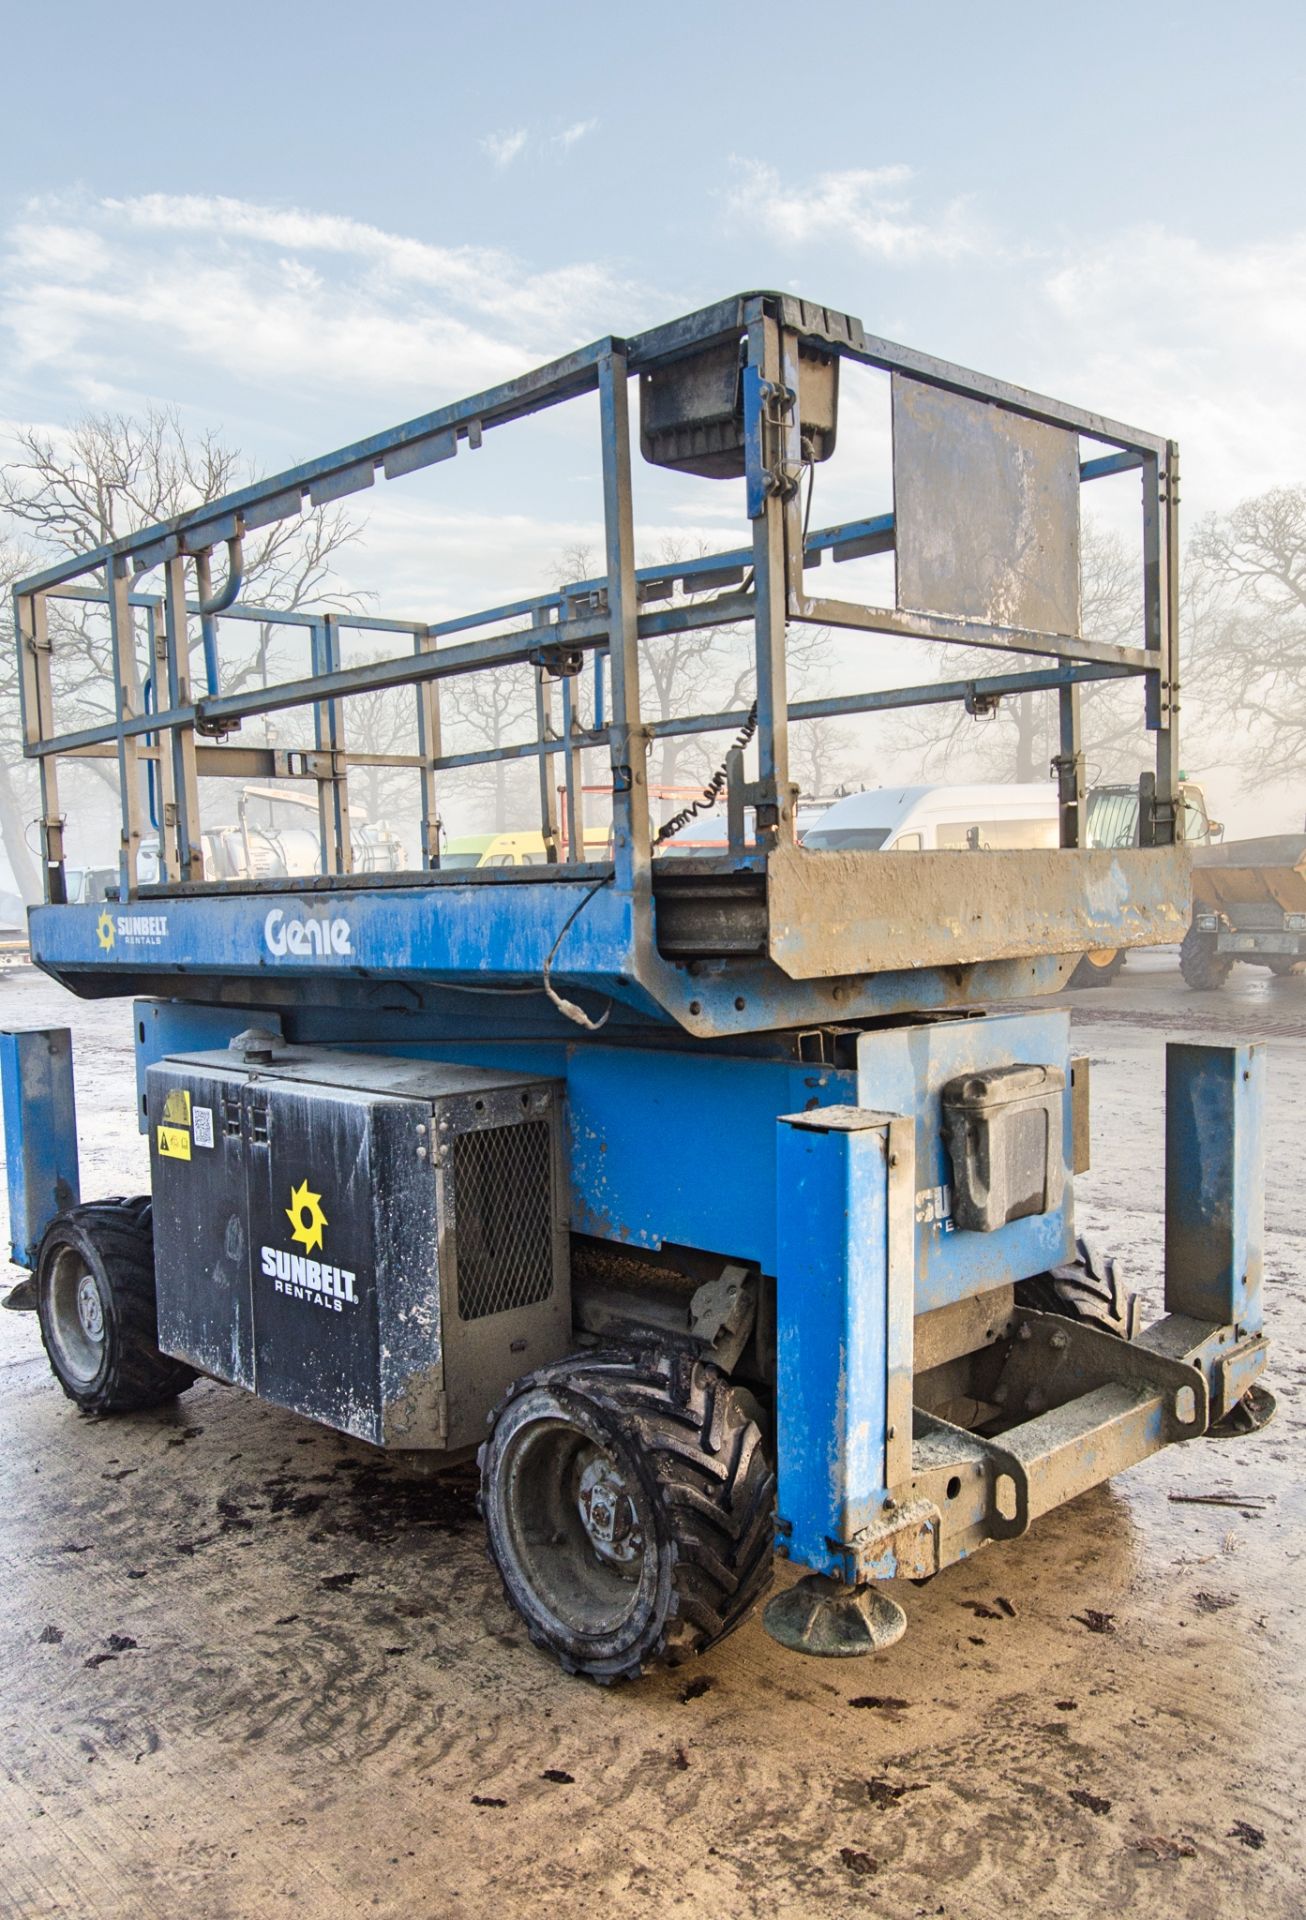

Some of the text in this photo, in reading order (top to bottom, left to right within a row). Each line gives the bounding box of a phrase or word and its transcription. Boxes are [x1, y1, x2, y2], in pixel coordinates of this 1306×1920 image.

[117, 916, 168, 936] SUNBELT
[125, 936, 161, 945] RENTALS
[264, 908, 351, 957] Genie
[261, 1246, 356, 1303] SUNBELT
[274, 1280, 343, 1312] RENTALS
